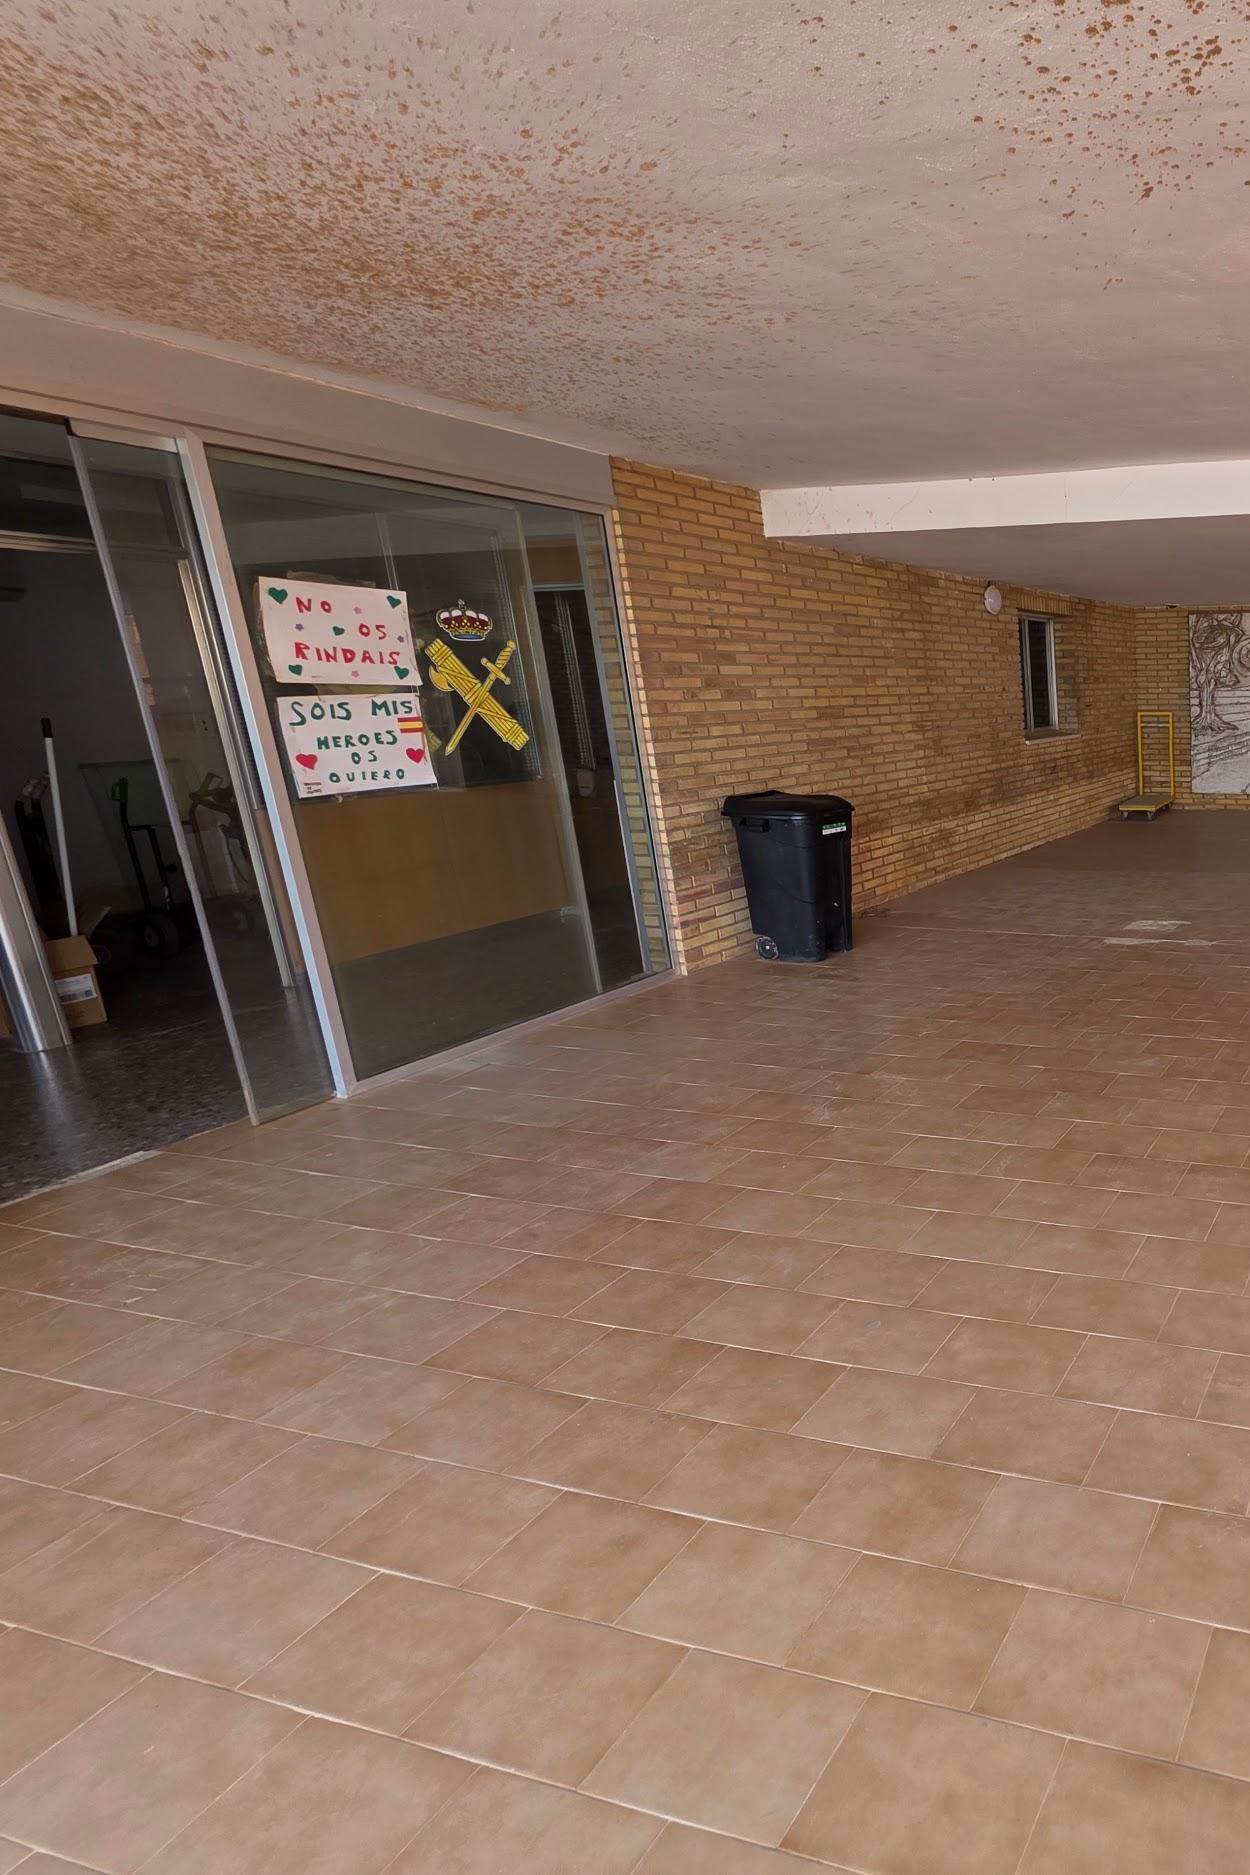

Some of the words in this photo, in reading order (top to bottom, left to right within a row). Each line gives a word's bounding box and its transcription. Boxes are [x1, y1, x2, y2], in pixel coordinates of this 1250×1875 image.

[295, 596, 332, 613] NO
[358, 623, 387, 640] OS
[294, 641, 401, 665] RINDAIS
[288, 700, 352, 727] SOIS
[371, 699, 413, 717] MIS
[317, 729, 398, 750] HEROES
[351, 751, 378, 764] OS
[329, 769, 405, 783] QUIERO
